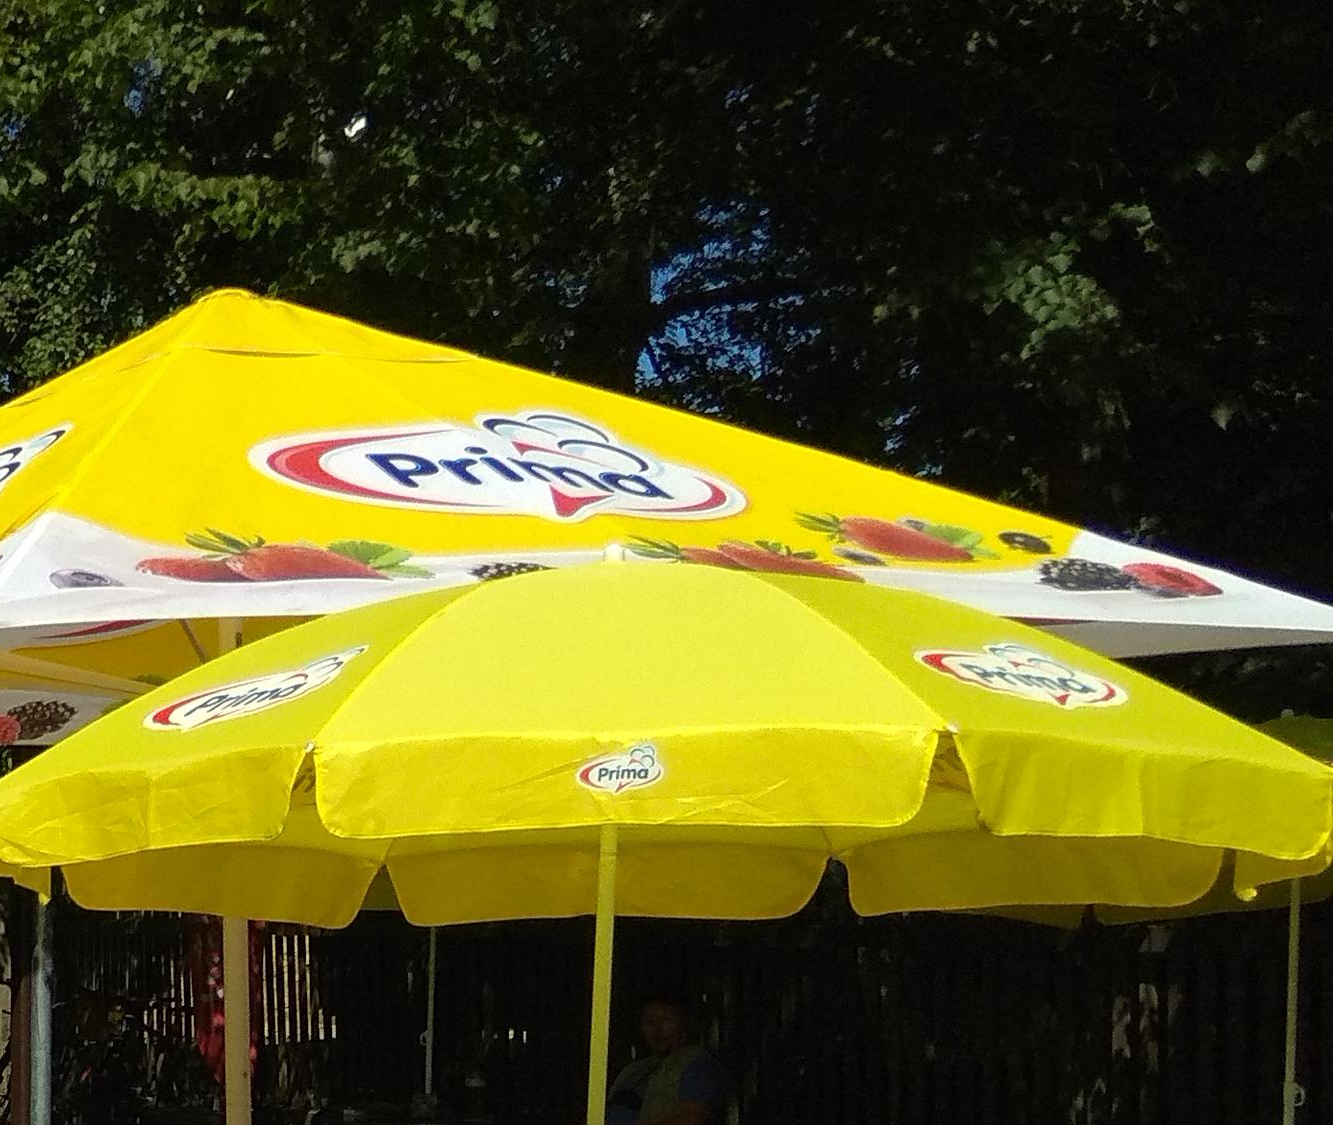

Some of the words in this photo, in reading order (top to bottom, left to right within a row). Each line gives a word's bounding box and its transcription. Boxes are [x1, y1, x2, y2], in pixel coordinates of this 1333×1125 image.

[364, 443, 674, 501] Prima
[959, 662, 1096, 695] Prima
[185, 678, 307, 717] Prima
[595, 763, 652, 784] Prima
